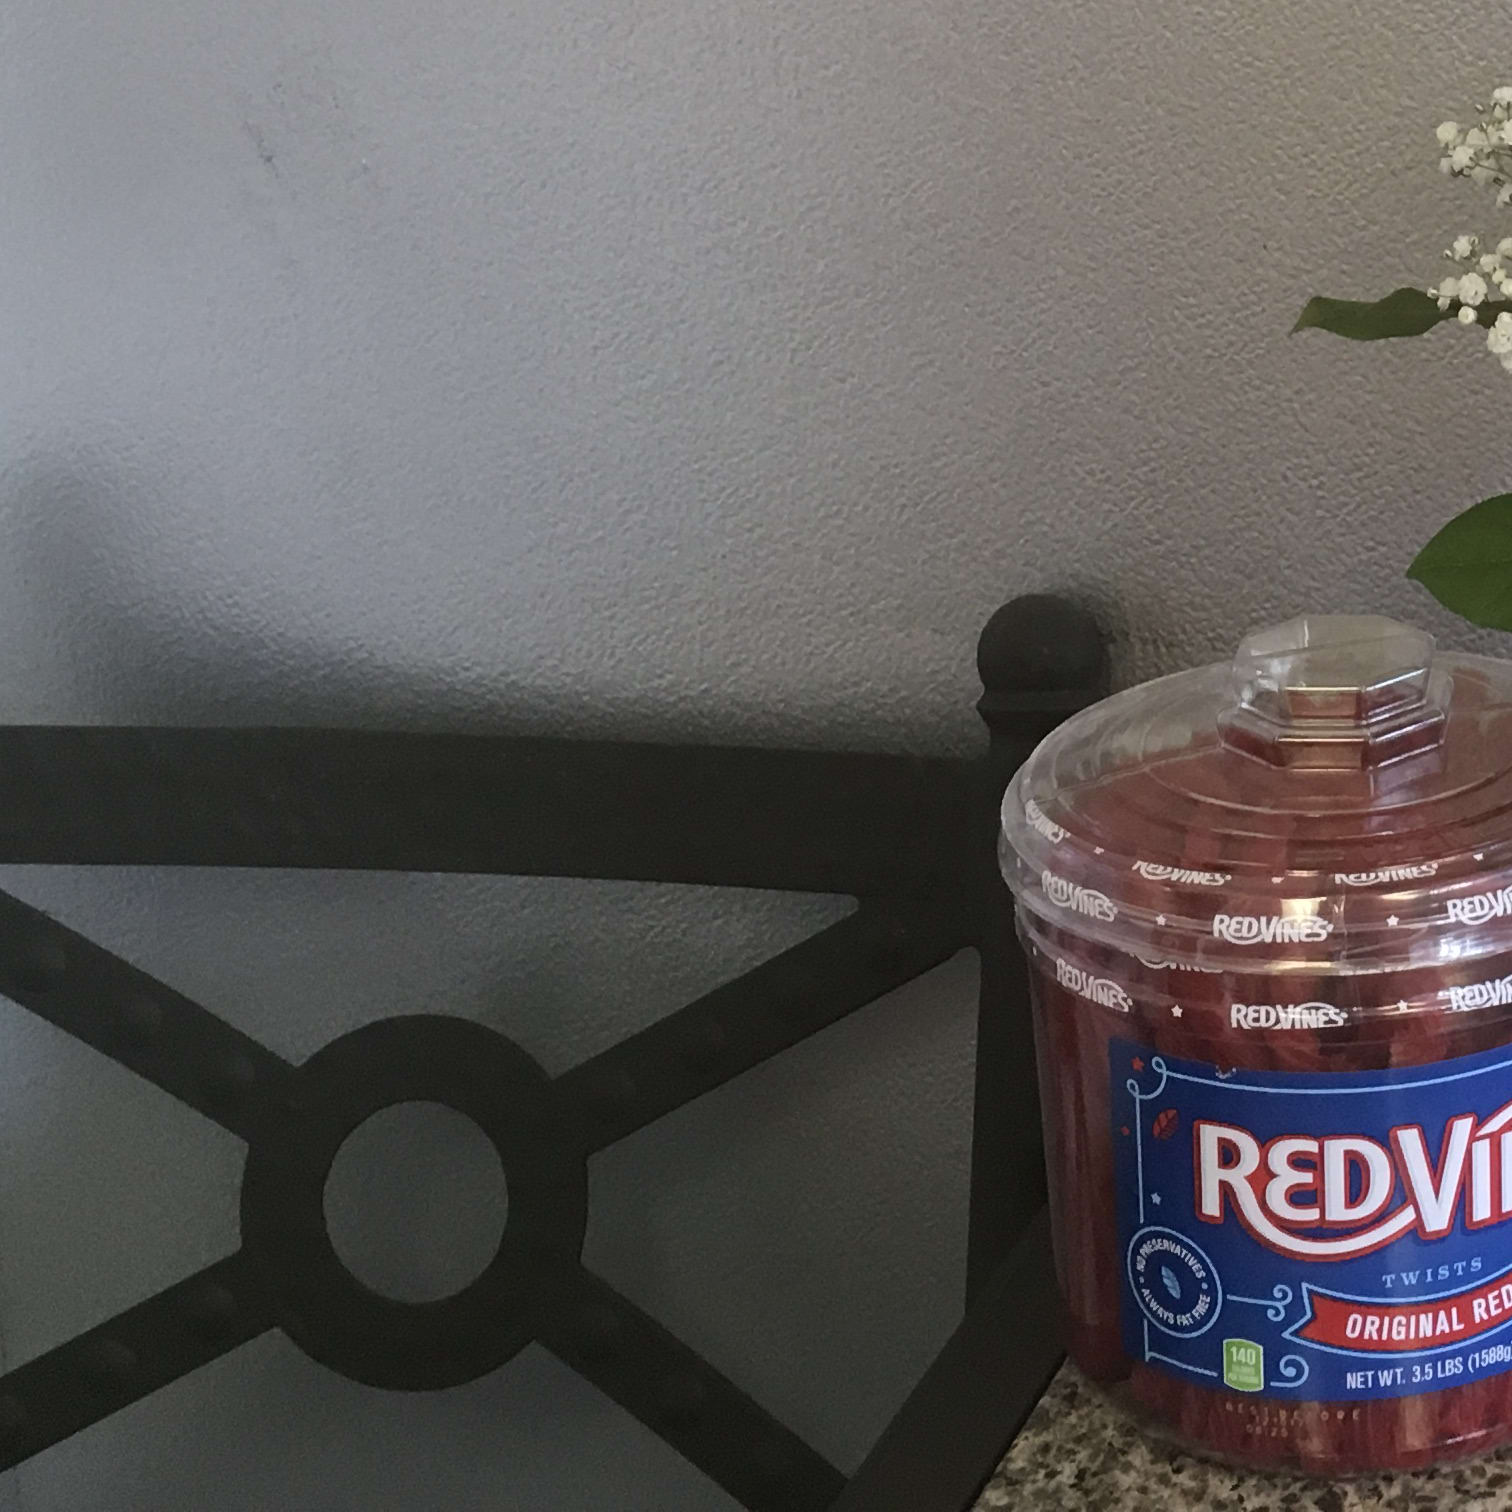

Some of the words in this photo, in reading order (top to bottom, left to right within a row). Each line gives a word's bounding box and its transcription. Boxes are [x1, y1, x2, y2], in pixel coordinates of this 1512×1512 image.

[1139, 1238, 1206, 1279] PRESERVATIVES
[1382, 1256, 1482, 1288] TWISTS
[1141, 1288, 1175, 1325] ALWAYS
[1345, 1306, 1465, 1342] ORIGINAL
[1231, 1346, 1256, 1366] 140
[1346, 1371, 1375, 1389] NET
[1377, 1367, 1406, 1387] WT.
[1411, 1362, 1434, 1383] 3.5
[1437, 1356, 1464, 1379] LBS
